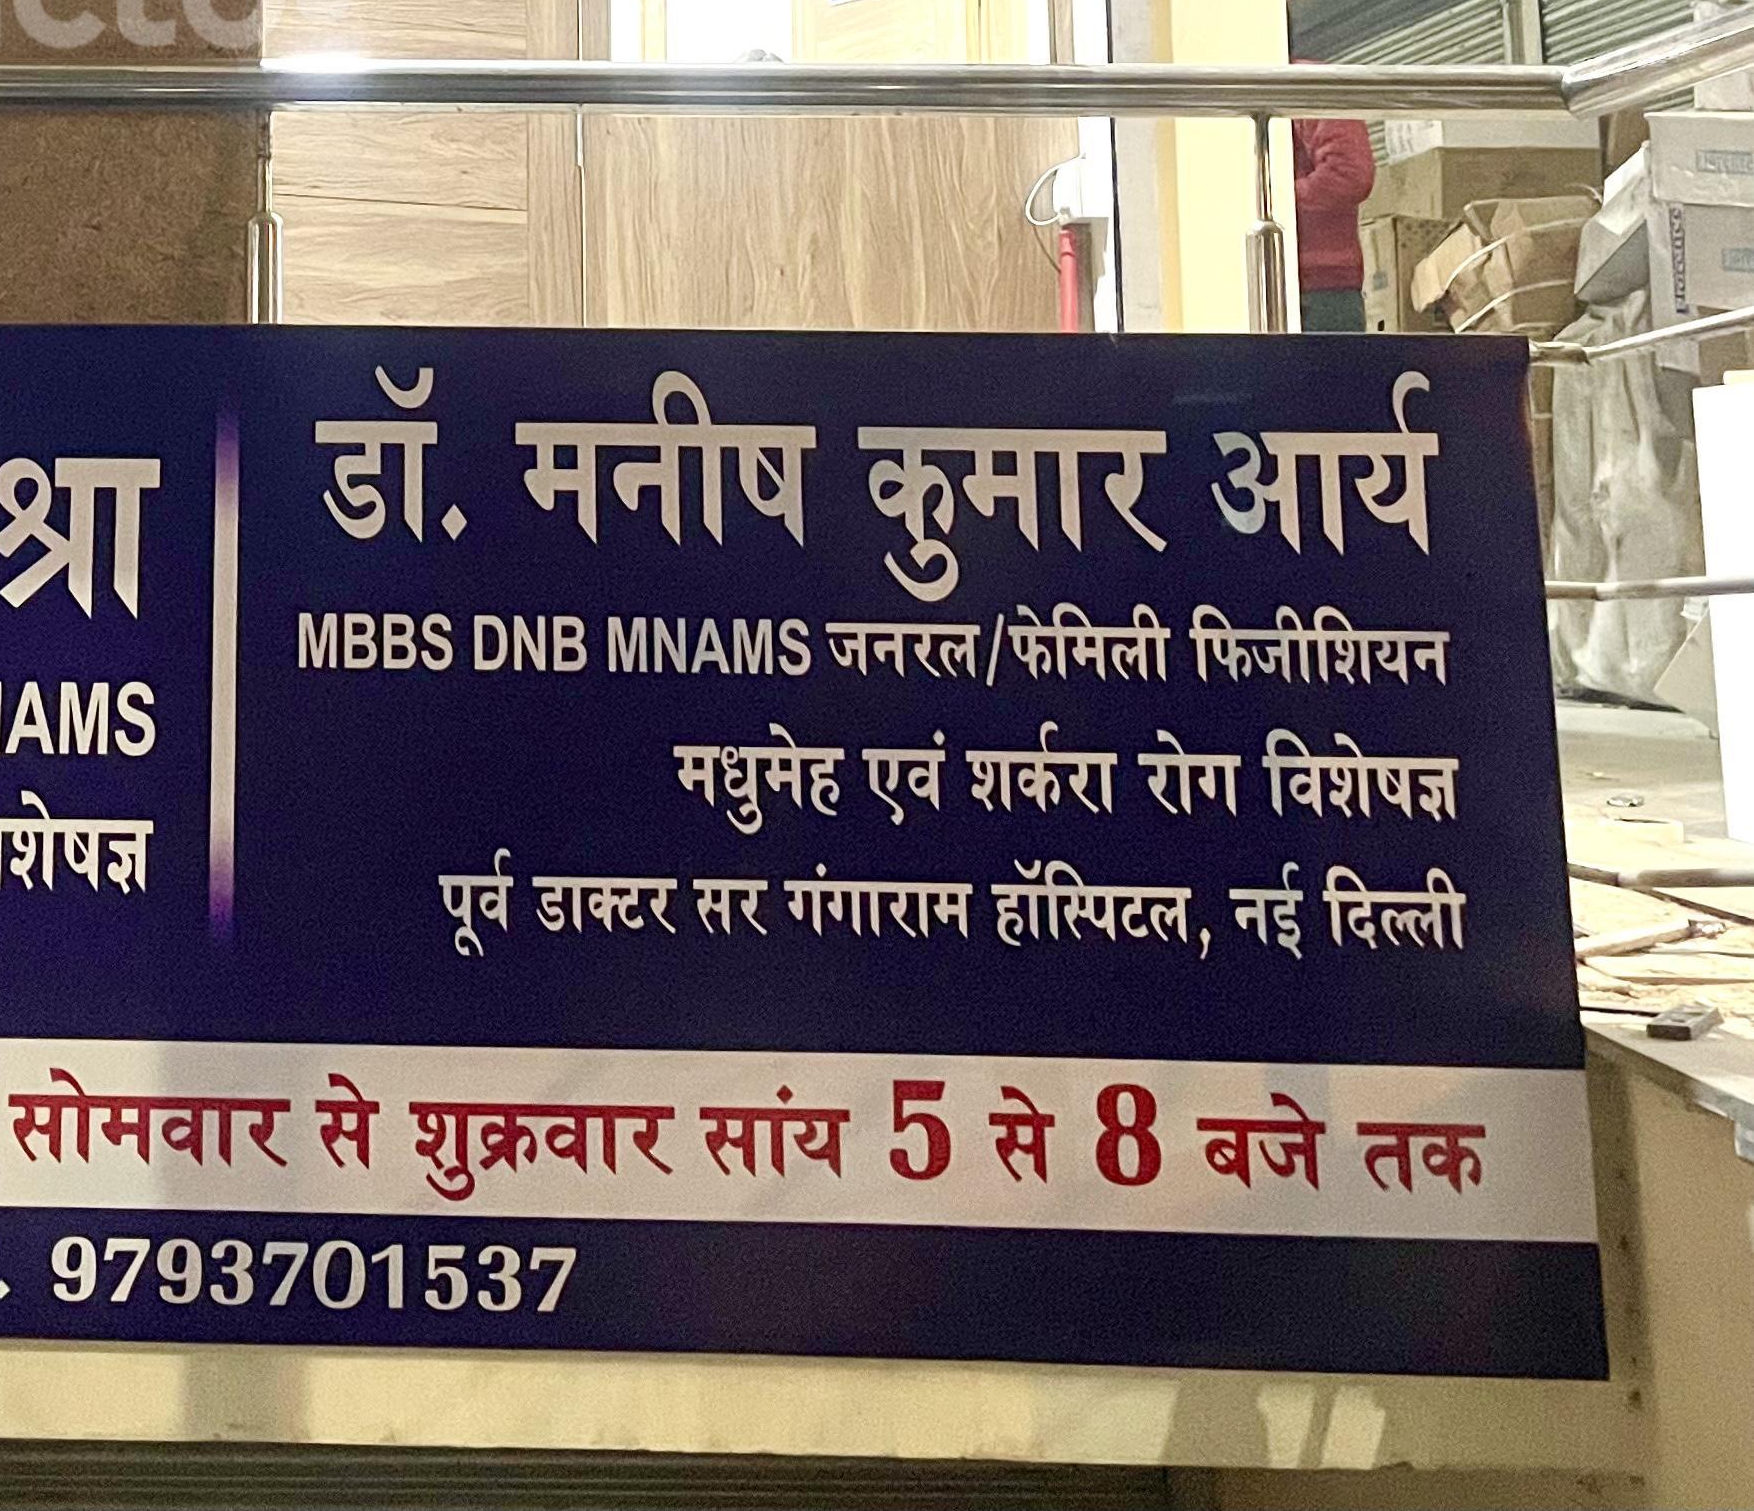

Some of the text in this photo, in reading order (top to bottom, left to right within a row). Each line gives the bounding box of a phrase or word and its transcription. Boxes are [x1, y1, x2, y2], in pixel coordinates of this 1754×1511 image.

[315, 366, 1439, 601] डॉ. मनीष कुमार आर्य
[299, 603, 1450, 686] MBBS DNB MNAMS जनरल/फेमिली फिजीशियन
[673, 721, 1459, 834] मधुमेह एवं शर्करा रोग विशेषज्ञ
[439, 848, 1466, 959] पूर्व डाक्टर सर गंगाराम हॉस्पिटल, नई दिल्ली
[9, 1068, 291, 1167] सोमवार
[315, 1073, 379, 1169] से
[409, 1102, 675, 1201] शुक्रवार
[700, 1085, 850, 1178] सांय
[890, 1080, 951, 1180] 5
[989, 1086, 1055, 1183] से
[1096, 1084, 1161, 1186] 8
[1197, 1093, 1326, 1190] बजे
[1357, 1122, 1486, 1193] तक
[52, 1237, 576, 1311] 9793701537
